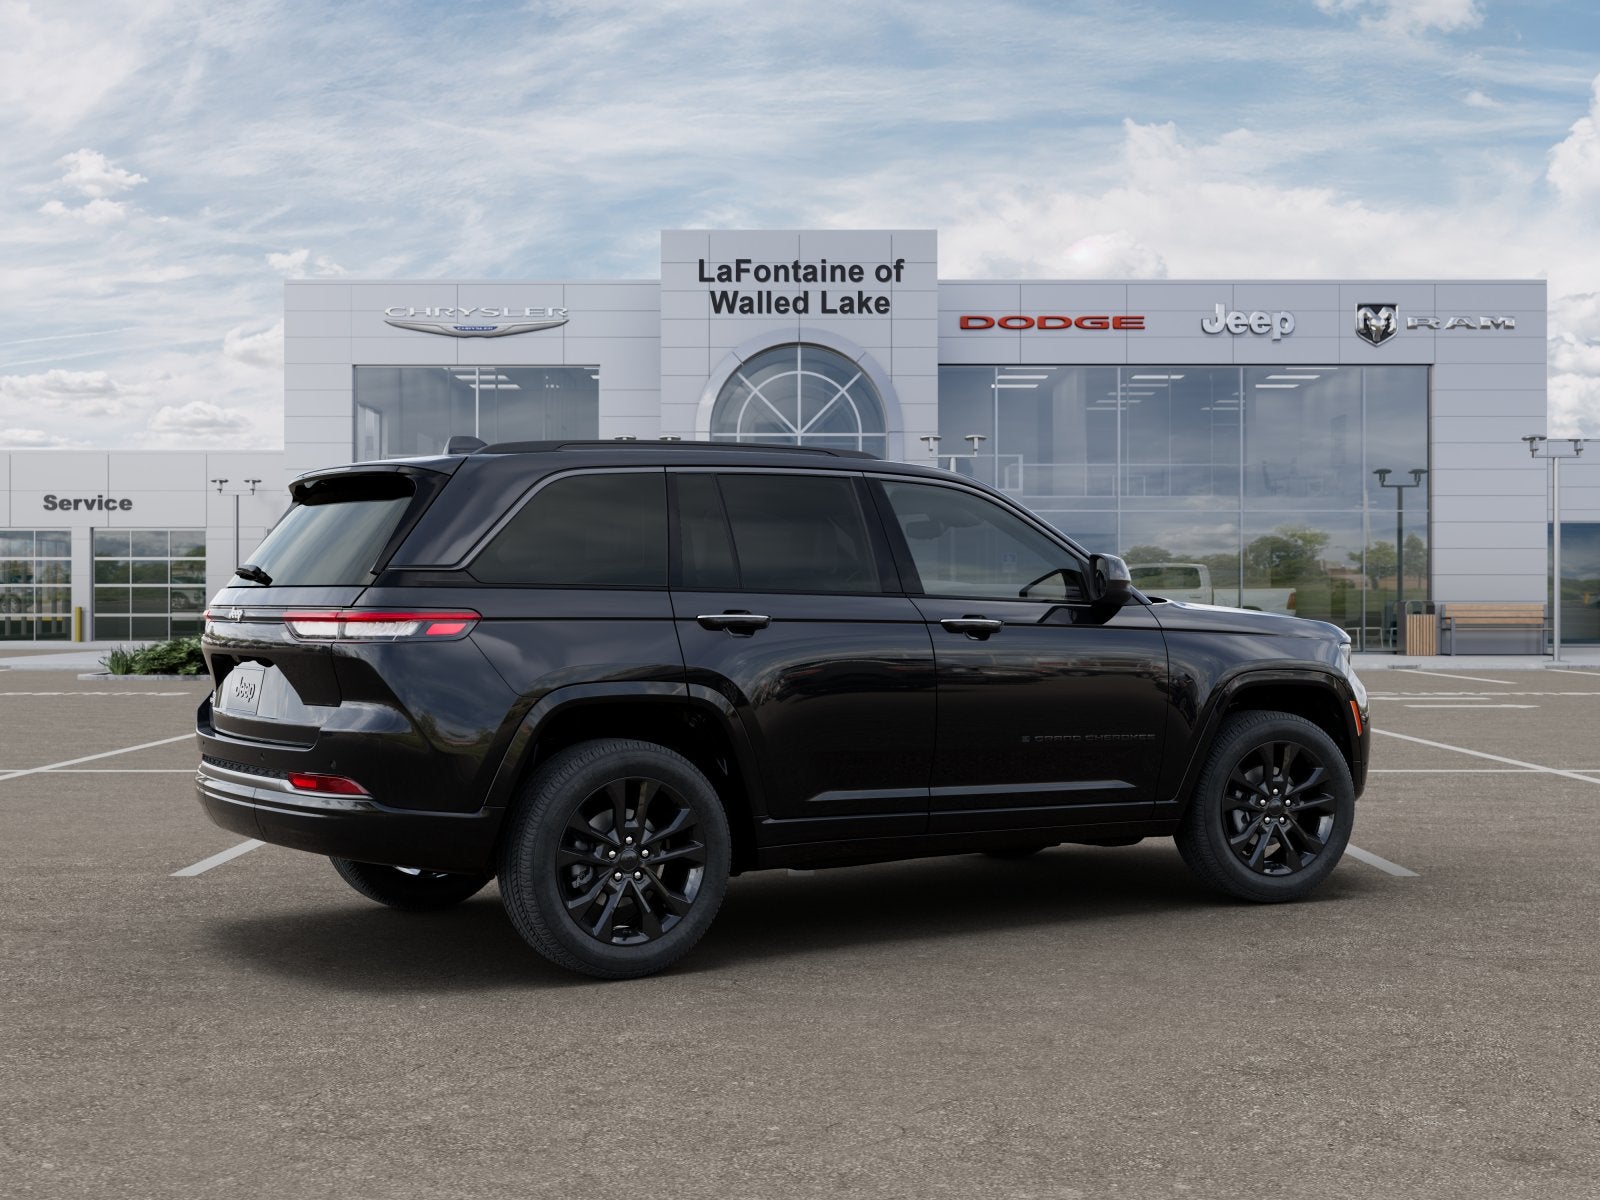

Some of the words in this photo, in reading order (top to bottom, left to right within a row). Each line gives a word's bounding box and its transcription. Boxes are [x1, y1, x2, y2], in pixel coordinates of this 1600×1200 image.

[698, 258, 864, 283] LaFontaine
[875, 258, 905, 283] of
[710, 290, 809, 314] Walled
[821, 290, 891, 314] Lake
[384, 306, 569, 317] CHRYSLER
[959, 315, 1146, 330] DODGE
[1201, 302, 1296, 341] Jeep
[1406, 316, 1516, 330] RAM
[43, 494, 133, 511] Service
